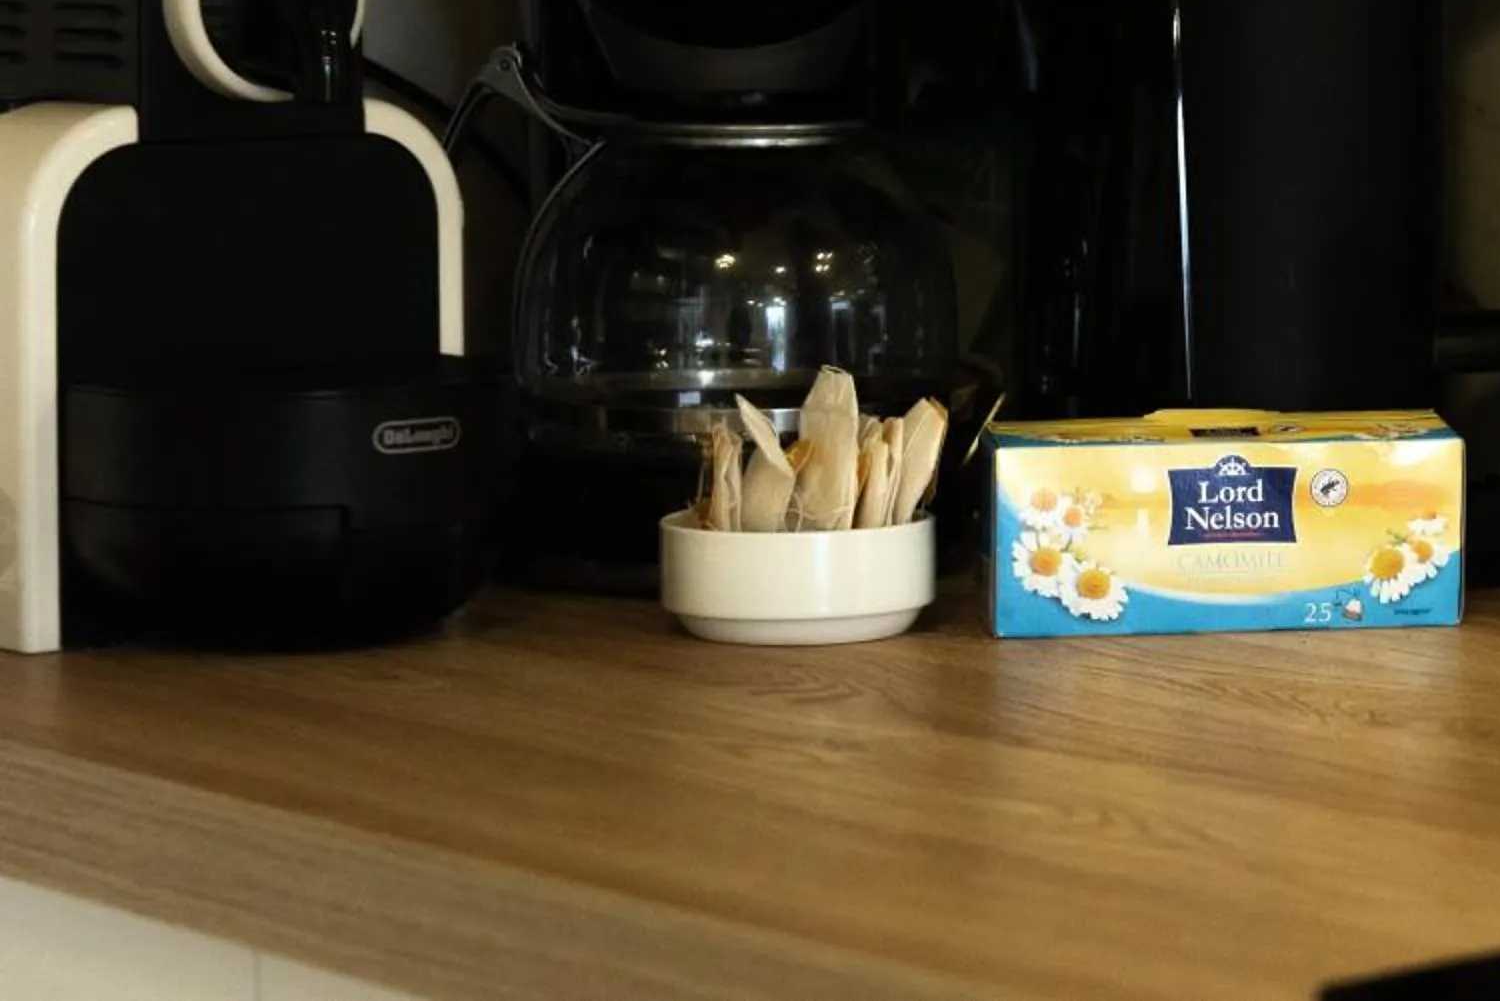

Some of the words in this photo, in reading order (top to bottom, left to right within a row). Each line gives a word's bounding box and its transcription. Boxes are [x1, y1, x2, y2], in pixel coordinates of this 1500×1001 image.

[1198, 479, 1264, 503] Lord
[1184, 505, 1280, 530] Nelson
[1303, 602, 1332, 622] 25
